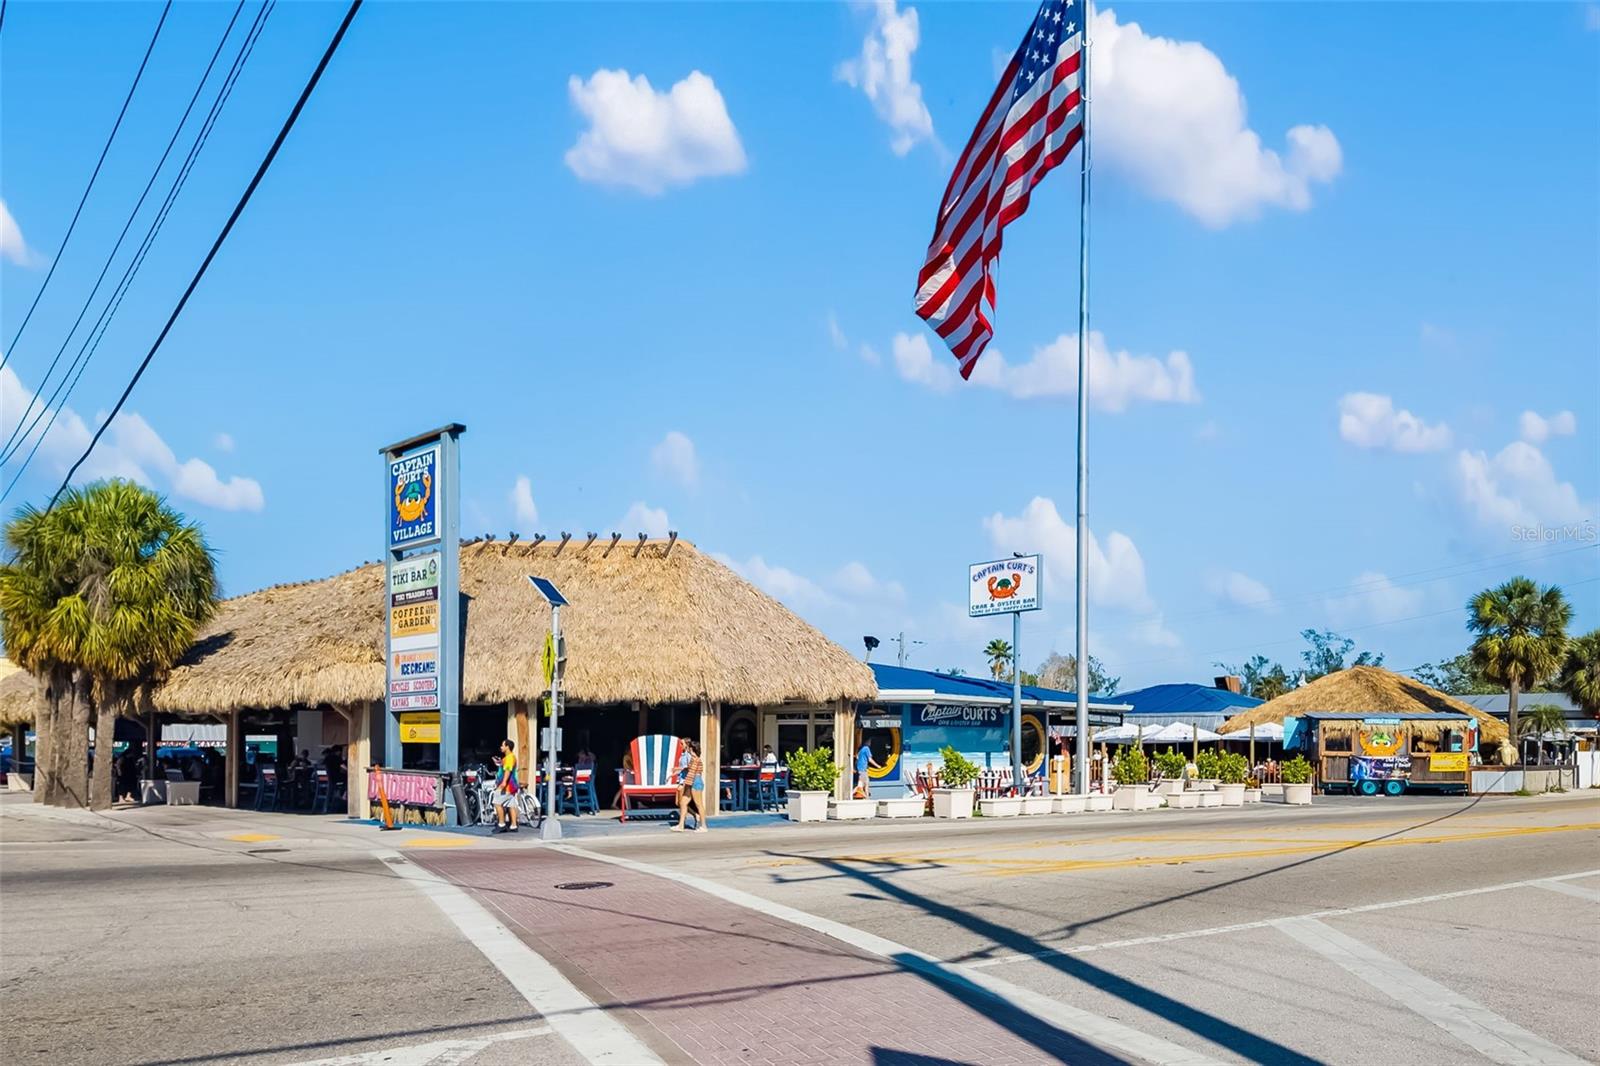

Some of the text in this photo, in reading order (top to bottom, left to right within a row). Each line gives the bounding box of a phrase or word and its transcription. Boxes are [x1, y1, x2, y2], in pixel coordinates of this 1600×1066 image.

[393, 453, 433, 476] CAPTAIN
[398, 466, 429, 485] CURT'S
[393, 521, 433, 541] VILLAGE
[392, 571, 409, 586] TIKI
[411, 569, 428, 582] BAR
[973, 561, 1035, 582] CAPTAIN CURT'S
[392, 606, 425, 620] COFFEE
[971, 602, 988, 611] CRAB
[998, 599, 1020, 607] OYSTER
[398, 615, 431, 629] GARDEN
[401, 663, 410, 676] ICE
[411, 661, 430, 675] CREAM
[391, 679, 435, 692] BICYCLES SCOOTERS
[391, 697, 409, 707] KAYAKS
[420, 695, 435, 706] TOURS
[921, 703, 997, 723] Captain CURT'S
